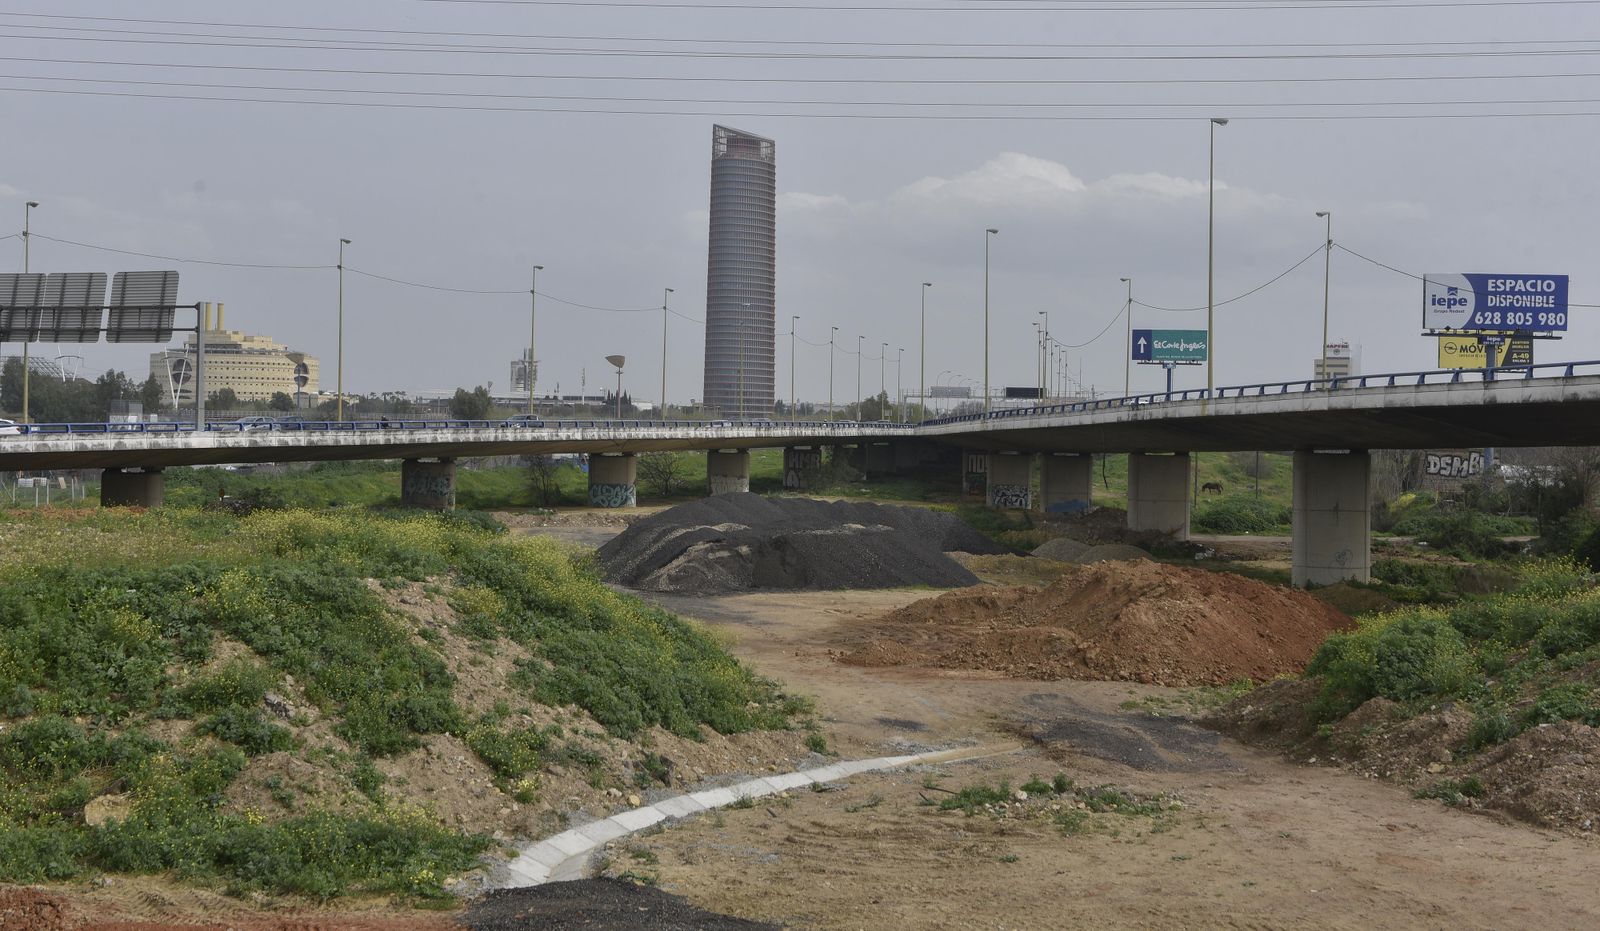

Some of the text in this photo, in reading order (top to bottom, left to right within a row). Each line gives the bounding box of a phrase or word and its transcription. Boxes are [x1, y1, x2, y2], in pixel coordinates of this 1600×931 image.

[1487, 279, 1556, 292] ESPACIO
[1431, 294, 1468, 309] iepe
[1487, 295, 1555, 308] DISPONIBLE
[1474, 312, 1566, 326] 628 805 980
[1153, 338, 1206, 352] El Corte Inglés
